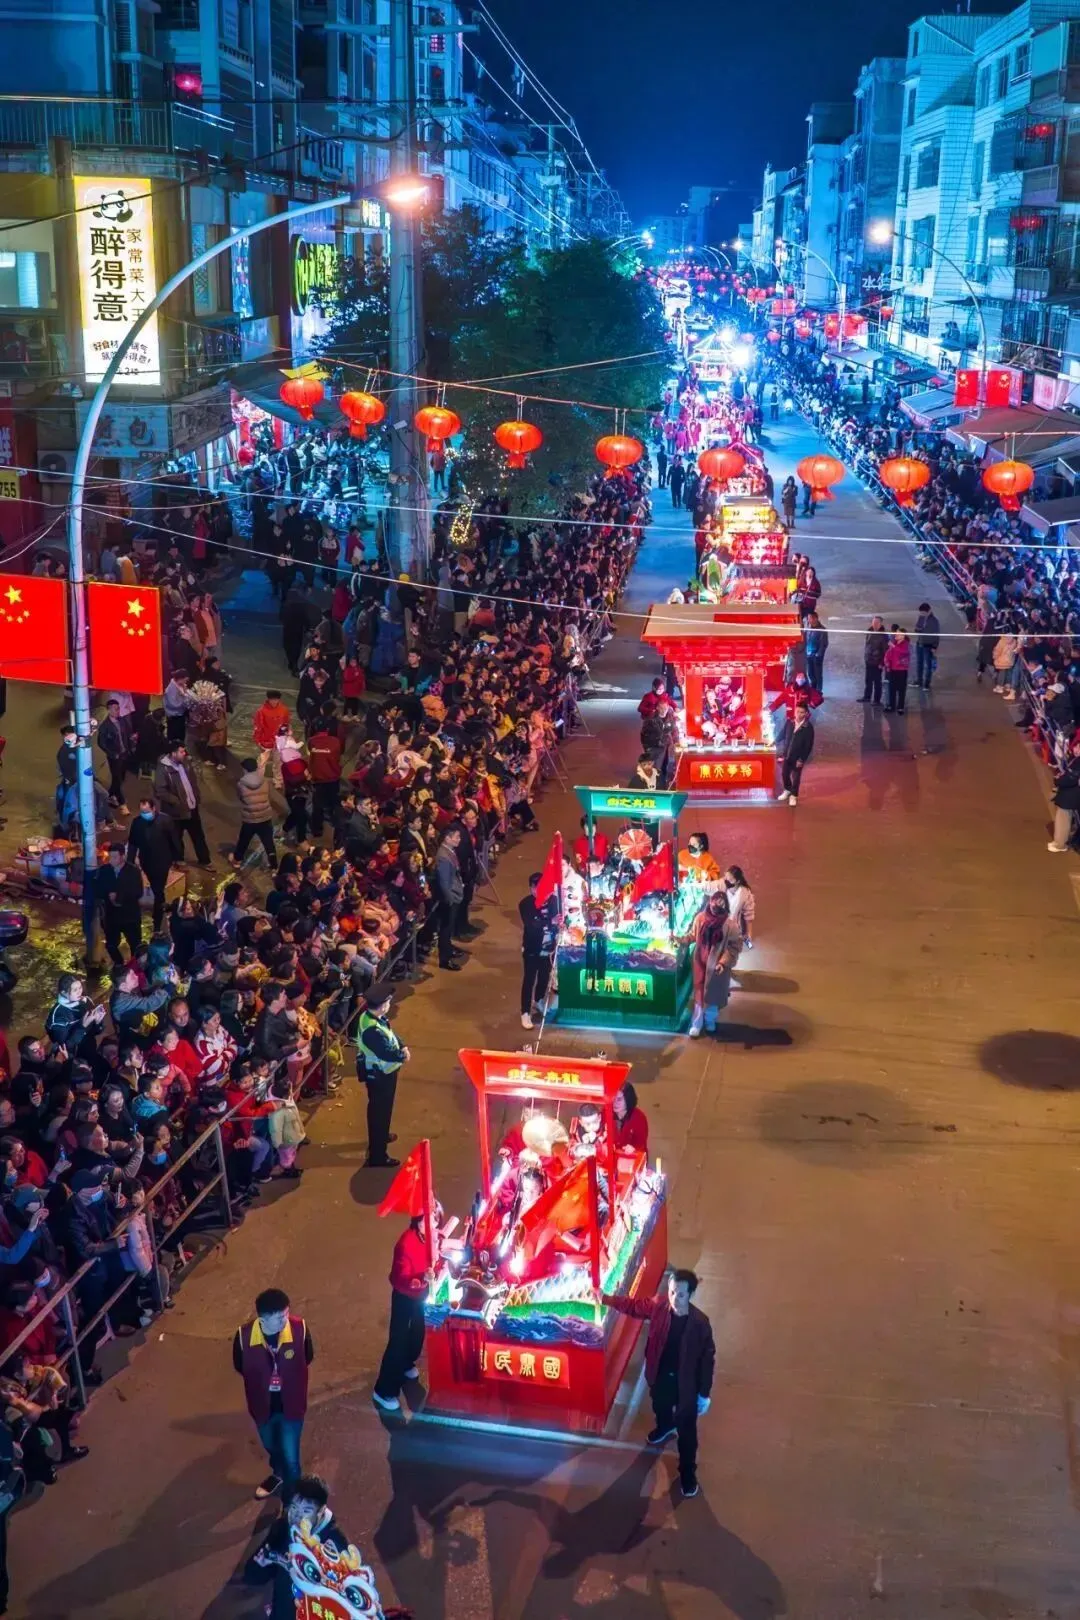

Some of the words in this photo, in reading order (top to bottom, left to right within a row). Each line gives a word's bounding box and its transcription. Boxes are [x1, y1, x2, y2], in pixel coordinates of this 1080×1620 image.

[90, 226, 128, 322] 醉得意
[126, 228, 146, 323] 家常菜大王
